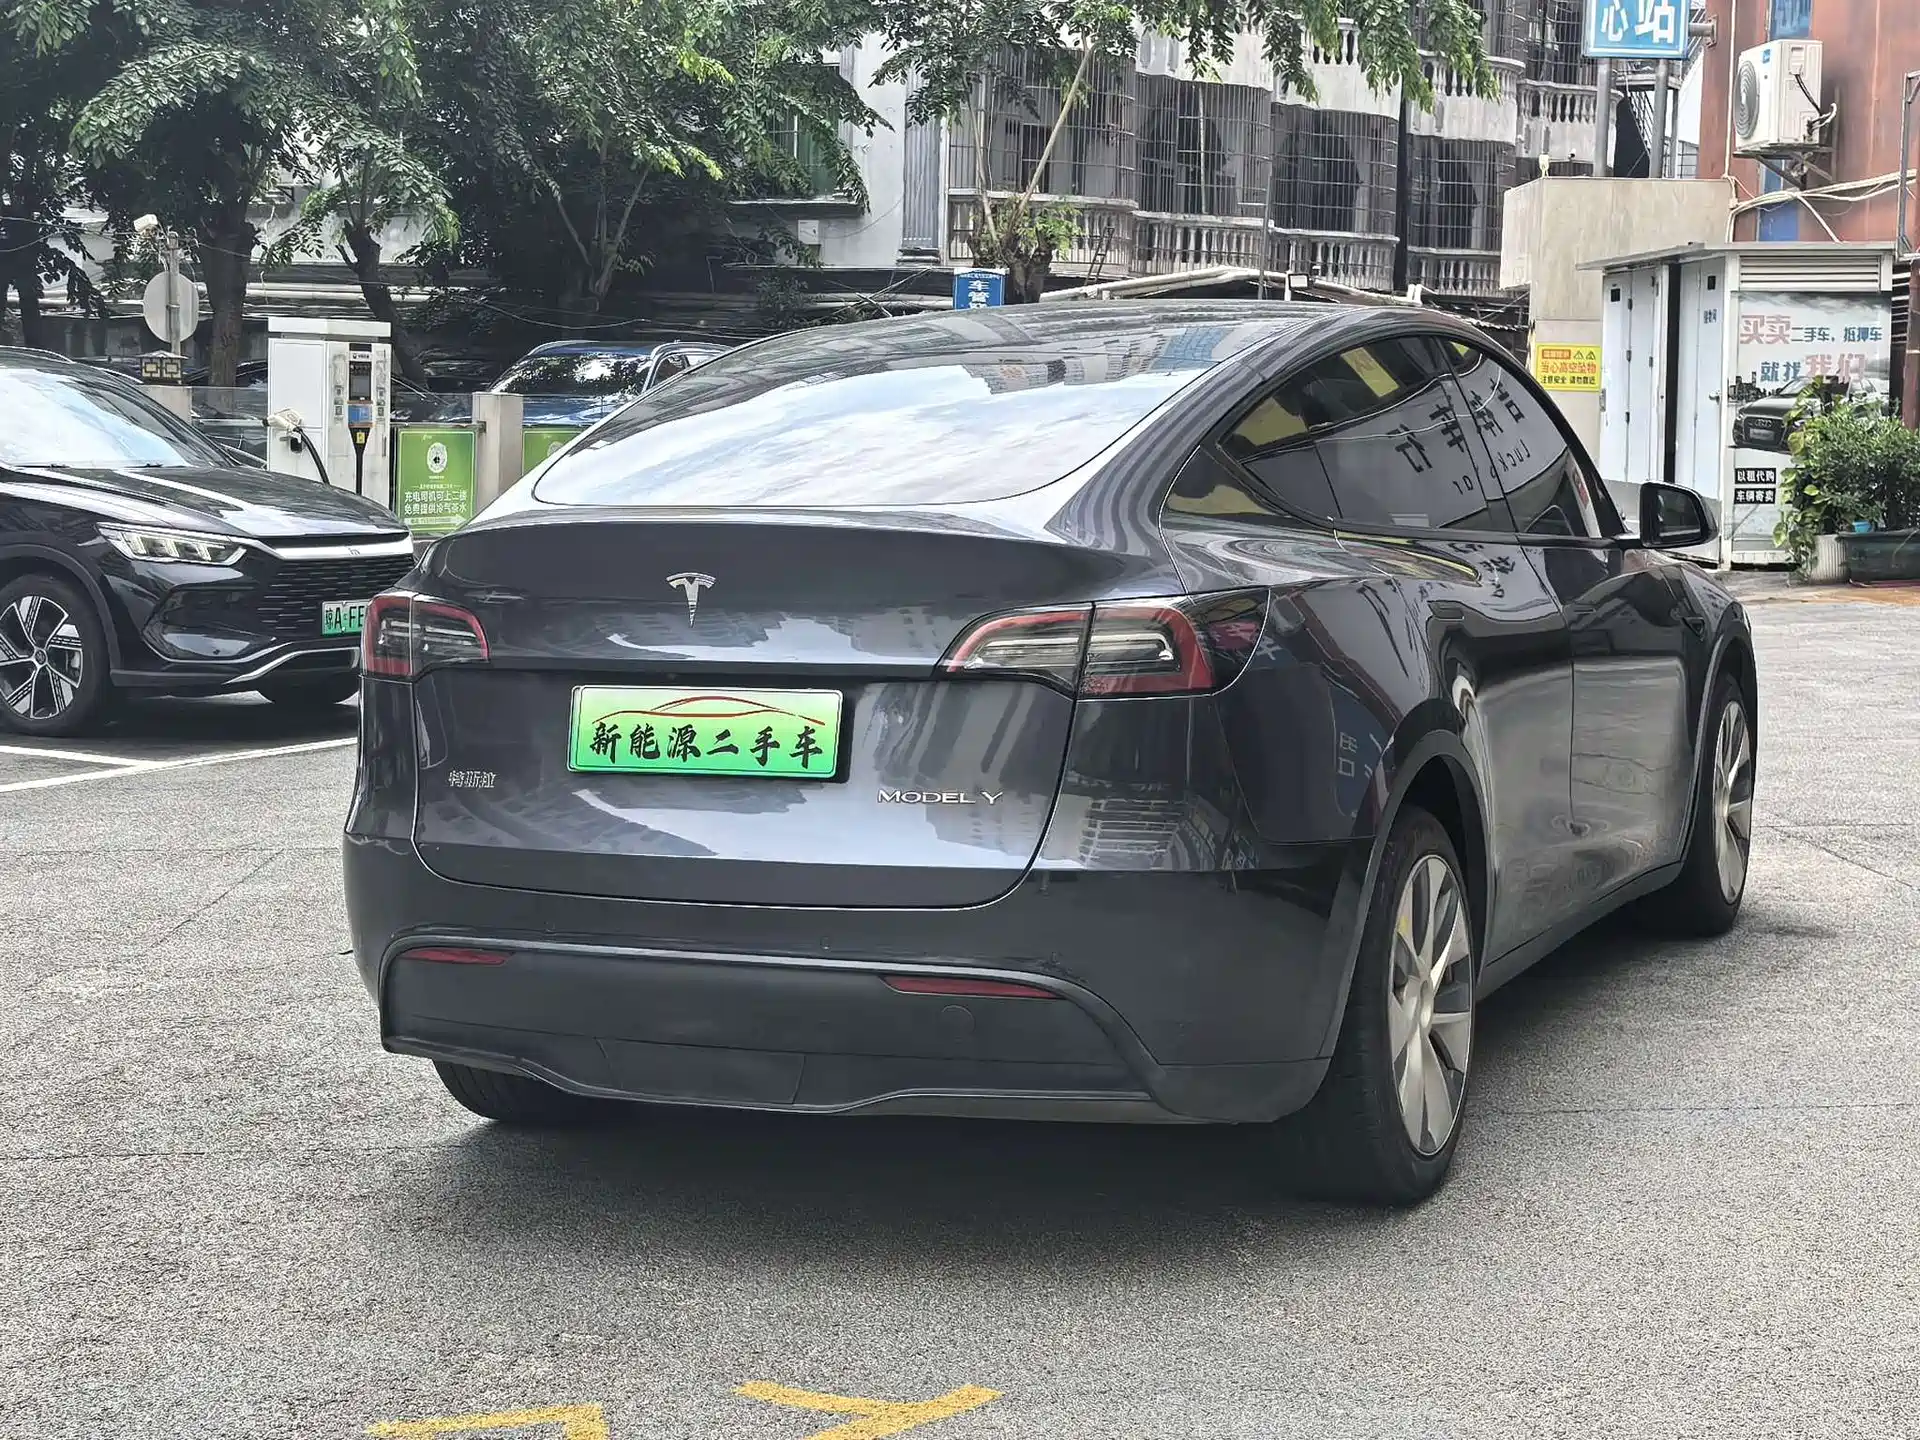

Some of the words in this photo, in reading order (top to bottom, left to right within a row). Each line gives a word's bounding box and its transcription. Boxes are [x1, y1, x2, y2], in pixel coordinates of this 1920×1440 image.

[1760, 353, 1866, 384] 就找我们
[590, 722, 824, 769] 新能源二手车
[448, 769, 496, 788] 特斯拉
[877, 789, 976, 804] MODEL
[981, 791, 1003, 805] Y
